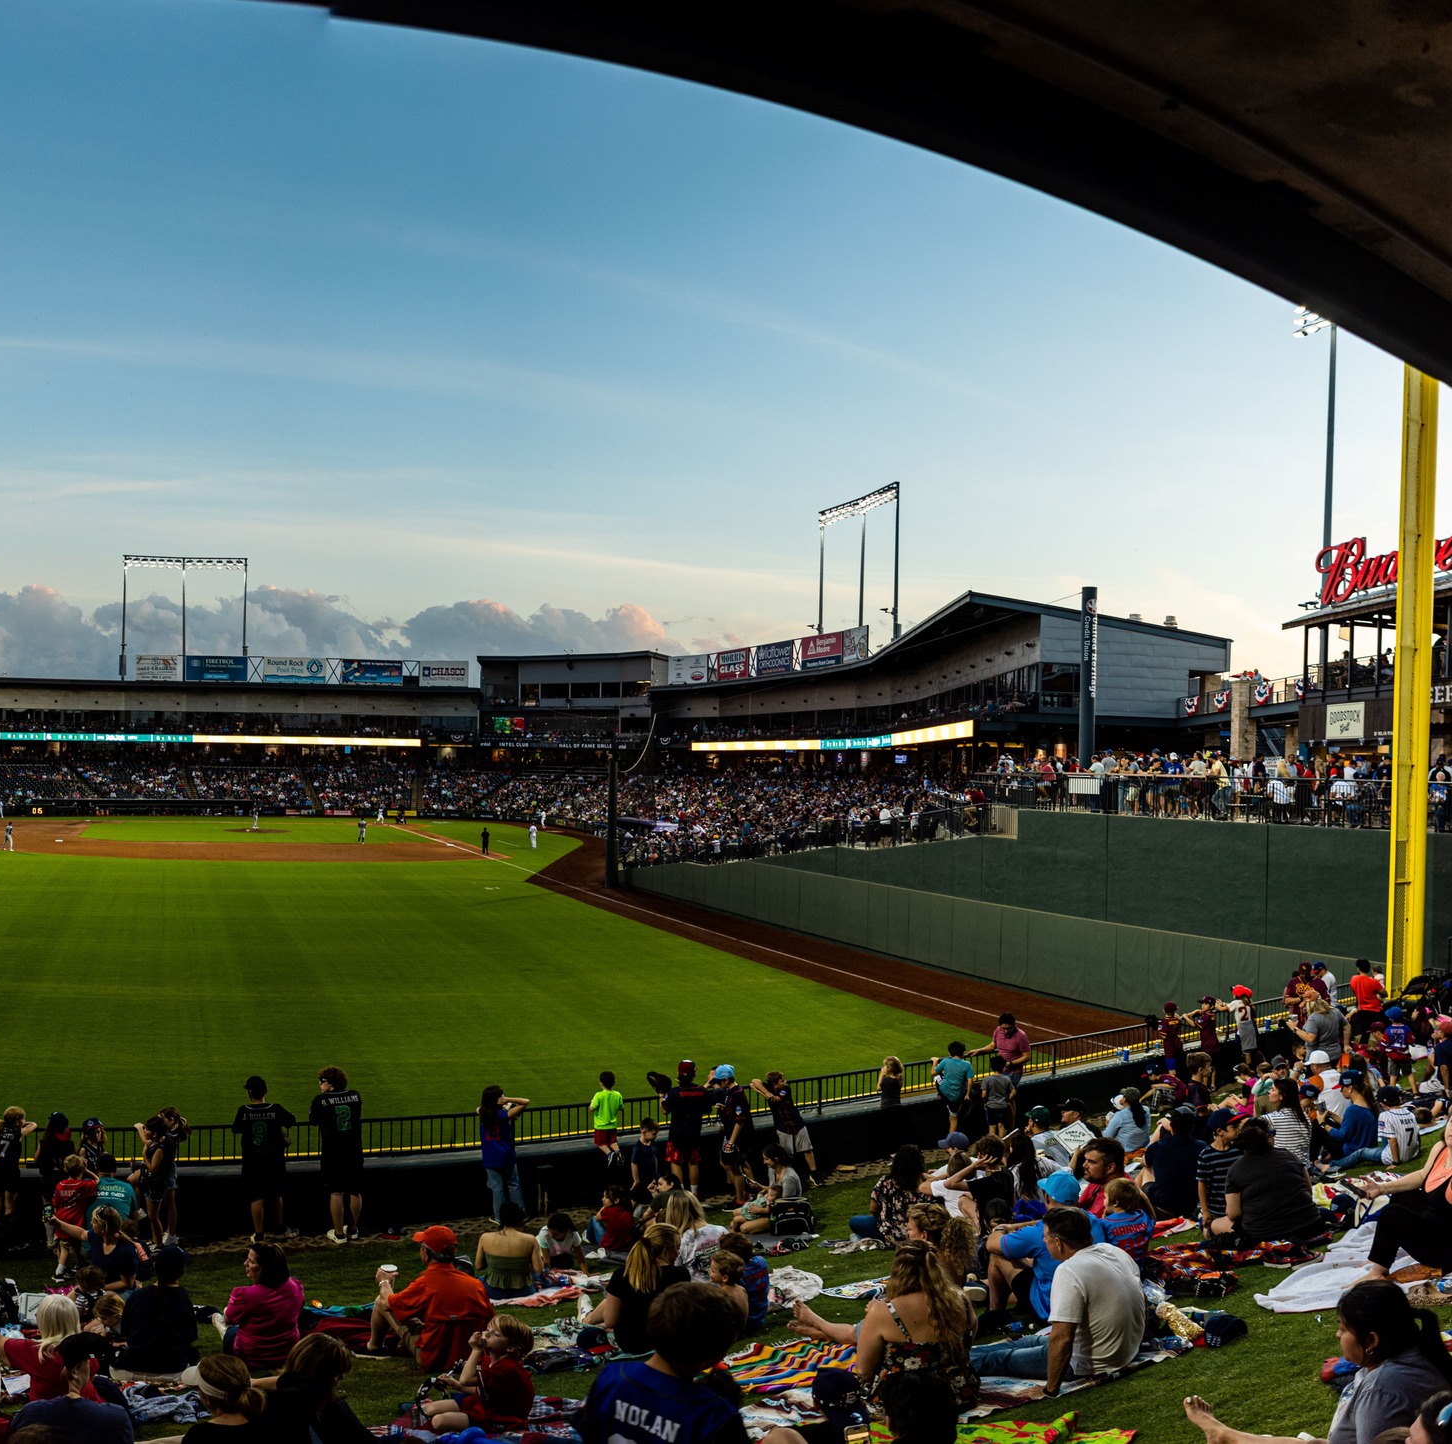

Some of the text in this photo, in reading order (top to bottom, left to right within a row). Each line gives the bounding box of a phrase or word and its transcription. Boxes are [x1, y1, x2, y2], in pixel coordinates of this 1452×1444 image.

[815, 636, 836, 647] Benjamin
[1083, 615, 1091, 661] Credit Union
[815, 646, 830, 654] Moore
[720, 651, 746, 664] MORRIS
[431, 667, 466, 676] CHASCO
[719, 663, 745, 674] GLASS
[1329, 709, 1361, 725] GOODSTOCK
[1238, 1007, 1249, 1022] 2
[329, 1094, 359, 1105] WILLIAMS
[334, 1104, 352, 1131] 2
[1405, 1128, 1414, 1146] 7
[1111, 1223, 1148, 1237] HARVEY
[614, 1398, 682, 1444] NOLAN
